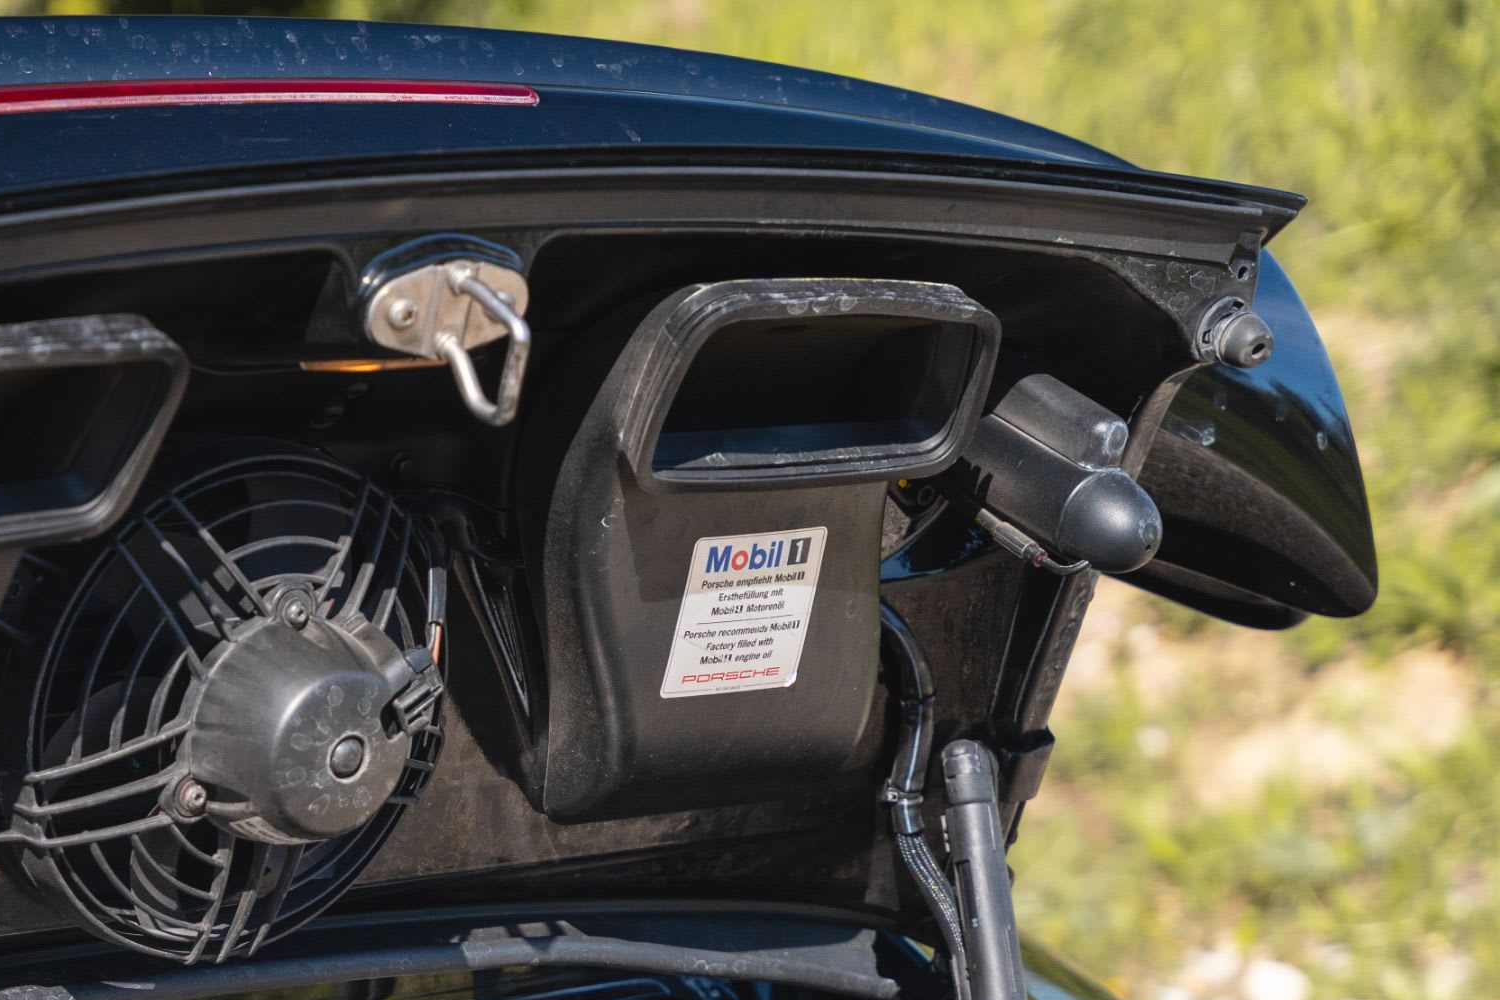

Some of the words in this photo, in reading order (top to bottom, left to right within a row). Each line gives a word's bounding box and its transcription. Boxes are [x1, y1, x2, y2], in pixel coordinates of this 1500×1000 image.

[705, 540, 784, 573] Mobil
[701, 578, 734, 589] Porsche
[736, 575, 772, 587] empfiehlt
[771, 588, 784, 597] mit
[746, 601, 785, 613] Motorenöl
[683, 630, 716, 639] Porsche
[718, 625, 768, 637] recommends
[706, 641, 735, 652] Factory
[737, 638, 756, 648] filled
[758, 637, 773, 646] with
[734, 652, 760, 662] engine
[762, 650, 772, 659] oil
[681, 666, 781, 684] PORSCHE
